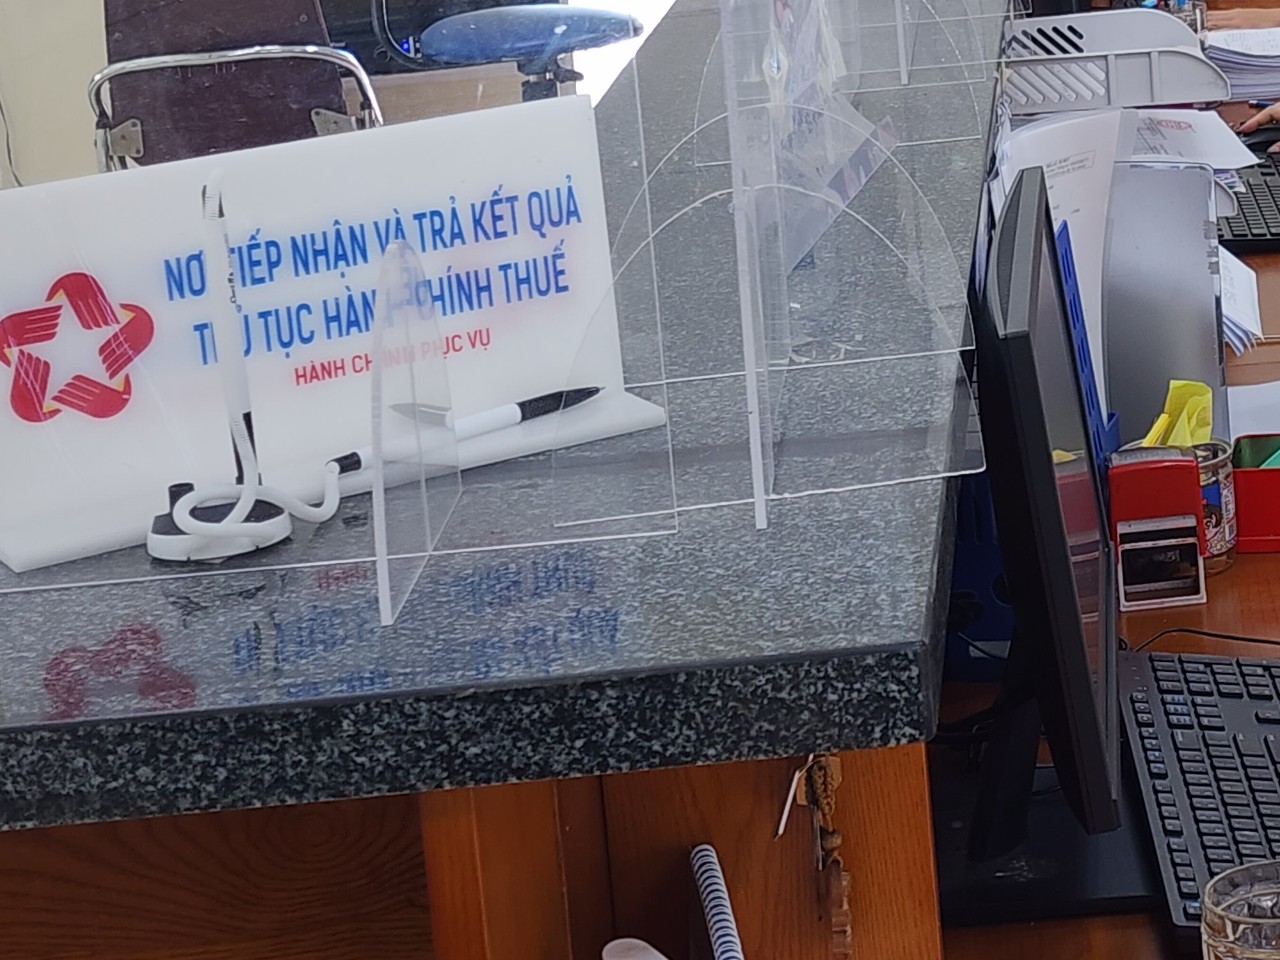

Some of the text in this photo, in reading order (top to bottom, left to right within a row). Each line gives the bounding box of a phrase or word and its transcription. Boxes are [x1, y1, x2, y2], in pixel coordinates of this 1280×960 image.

[289, 218, 369, 279] NHẬN
[373, 207, 407, 256] VÀ
[412, 196, 468, 253] TRẢ
[470, 184, 520, 244] KẾT
[527, 174, 583, 239] QUẢ
[257, 302, 316, 359] TỤC
[415, 265, 494, 317] CHÍNH
[497, 238, 570, 304] THUẾ
[294, 358, 346, 387] HÀNH
[466, 327, 492, 352] VỤ
